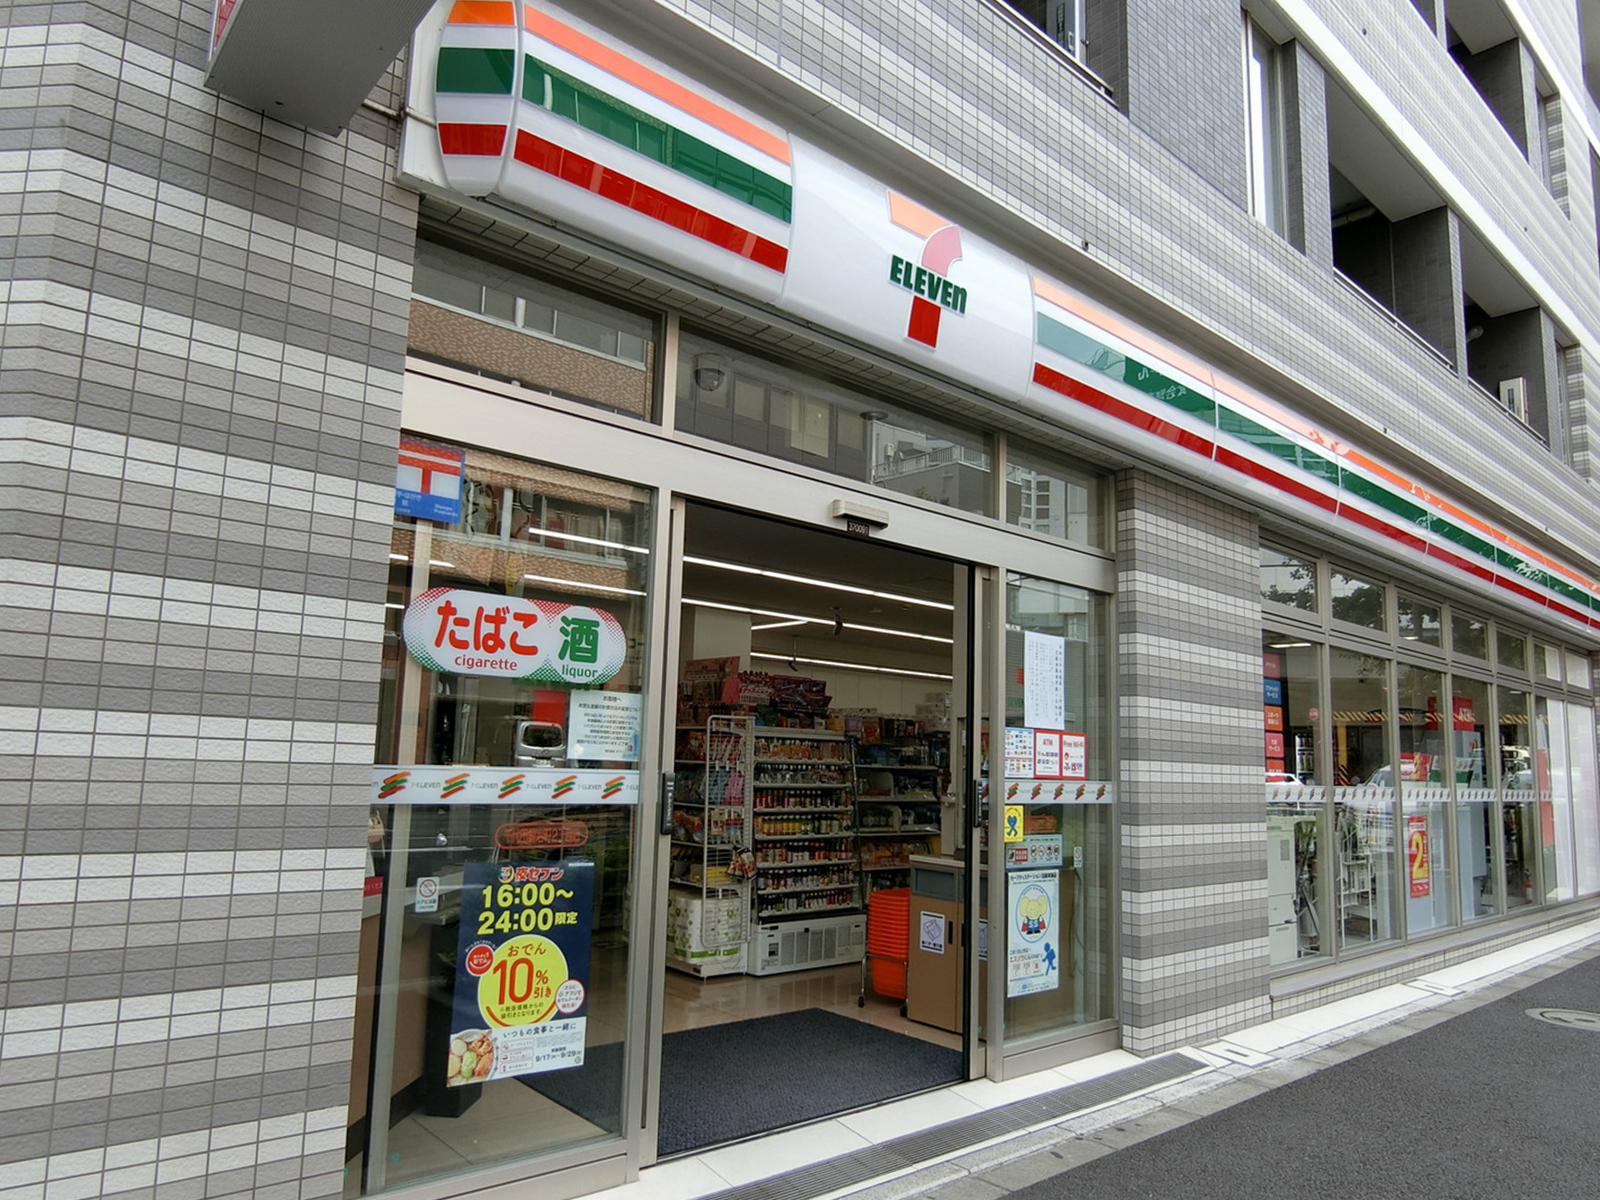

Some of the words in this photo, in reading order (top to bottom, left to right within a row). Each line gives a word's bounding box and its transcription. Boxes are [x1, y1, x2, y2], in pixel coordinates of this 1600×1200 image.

[434, 600, 539, 656] たばこ
[558, 615, 601, 665] 酒
[454, 654, 518, 671] cigarette
[561, 664, 599, 679] liquor
[514, 866, 565, 882] 夜セブン
[507, 942, 547, 957] おでん
[533, 985, 552, 999] 引き
[503, 1022, 577, 1039] いつもの食事と一緒に
